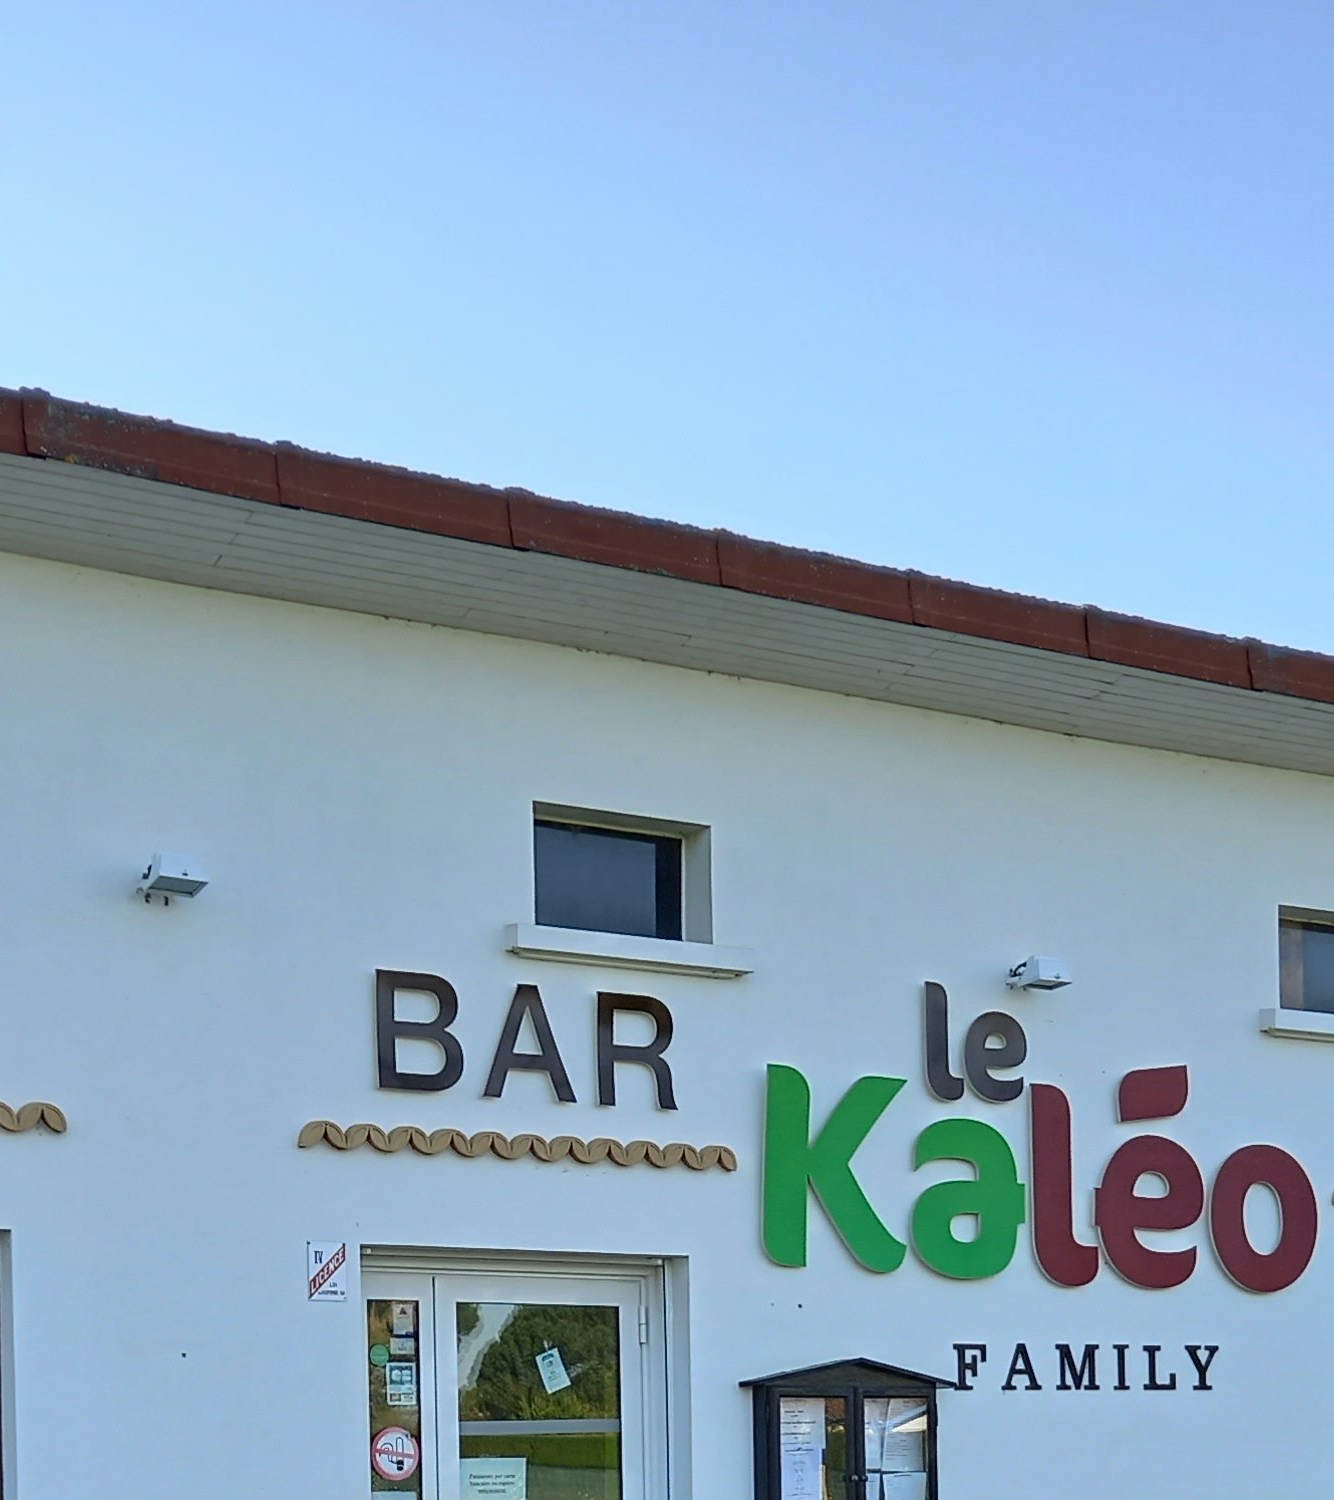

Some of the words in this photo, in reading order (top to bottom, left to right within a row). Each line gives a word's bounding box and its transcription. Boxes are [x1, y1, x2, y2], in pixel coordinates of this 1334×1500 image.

[374, 969, 678, 1110] BAR
[923, 981, 1028, 1103] le
[762, 1063, 1318, 1294] Kaléo
[310, 1246, 346, 1296] LICENCE
[314, 1250, 324, 1264] IV
[952, 1342, 1220, 1392] FAMILY
